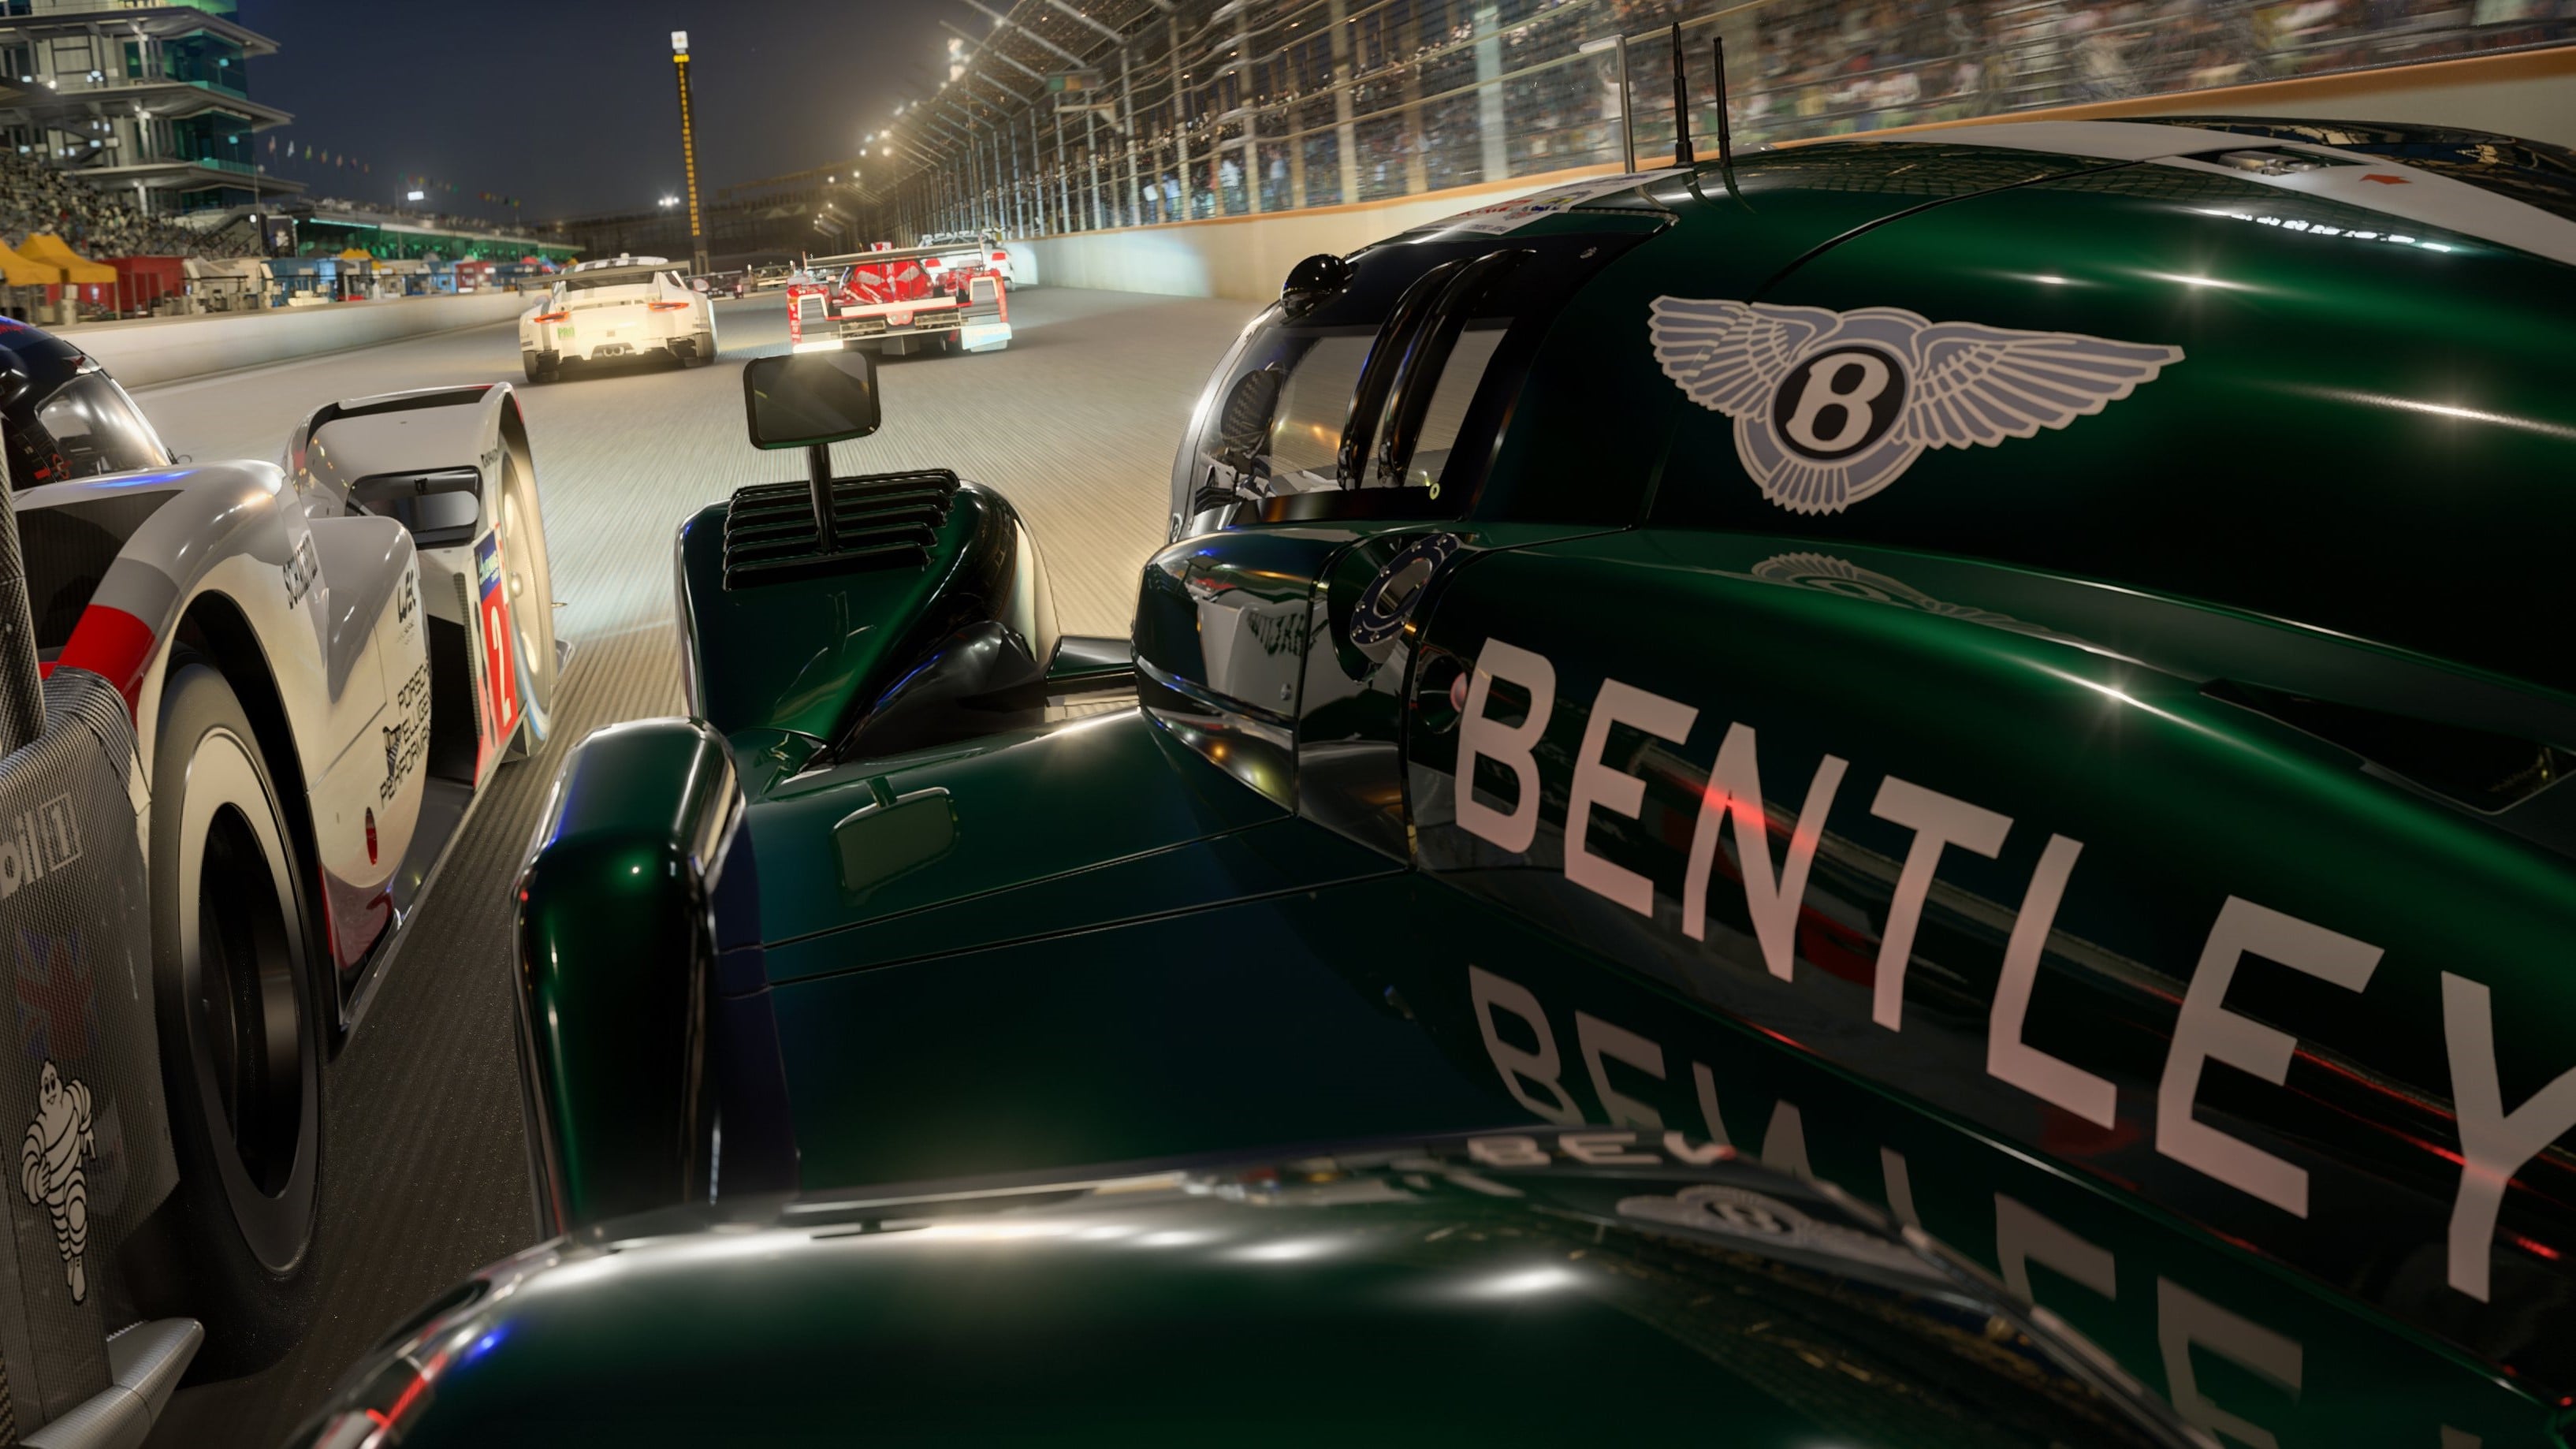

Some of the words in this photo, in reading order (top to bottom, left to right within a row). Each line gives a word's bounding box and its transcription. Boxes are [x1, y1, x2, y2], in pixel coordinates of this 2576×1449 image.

[921, 226, 1006, 240] BENTLEY
[557, 326, 575, 341] PRO
[1785, 352, 1890, 453] B
[490, 605, 512, 727] 2
[1456, 637, 2576, 1302] BENTLEY
